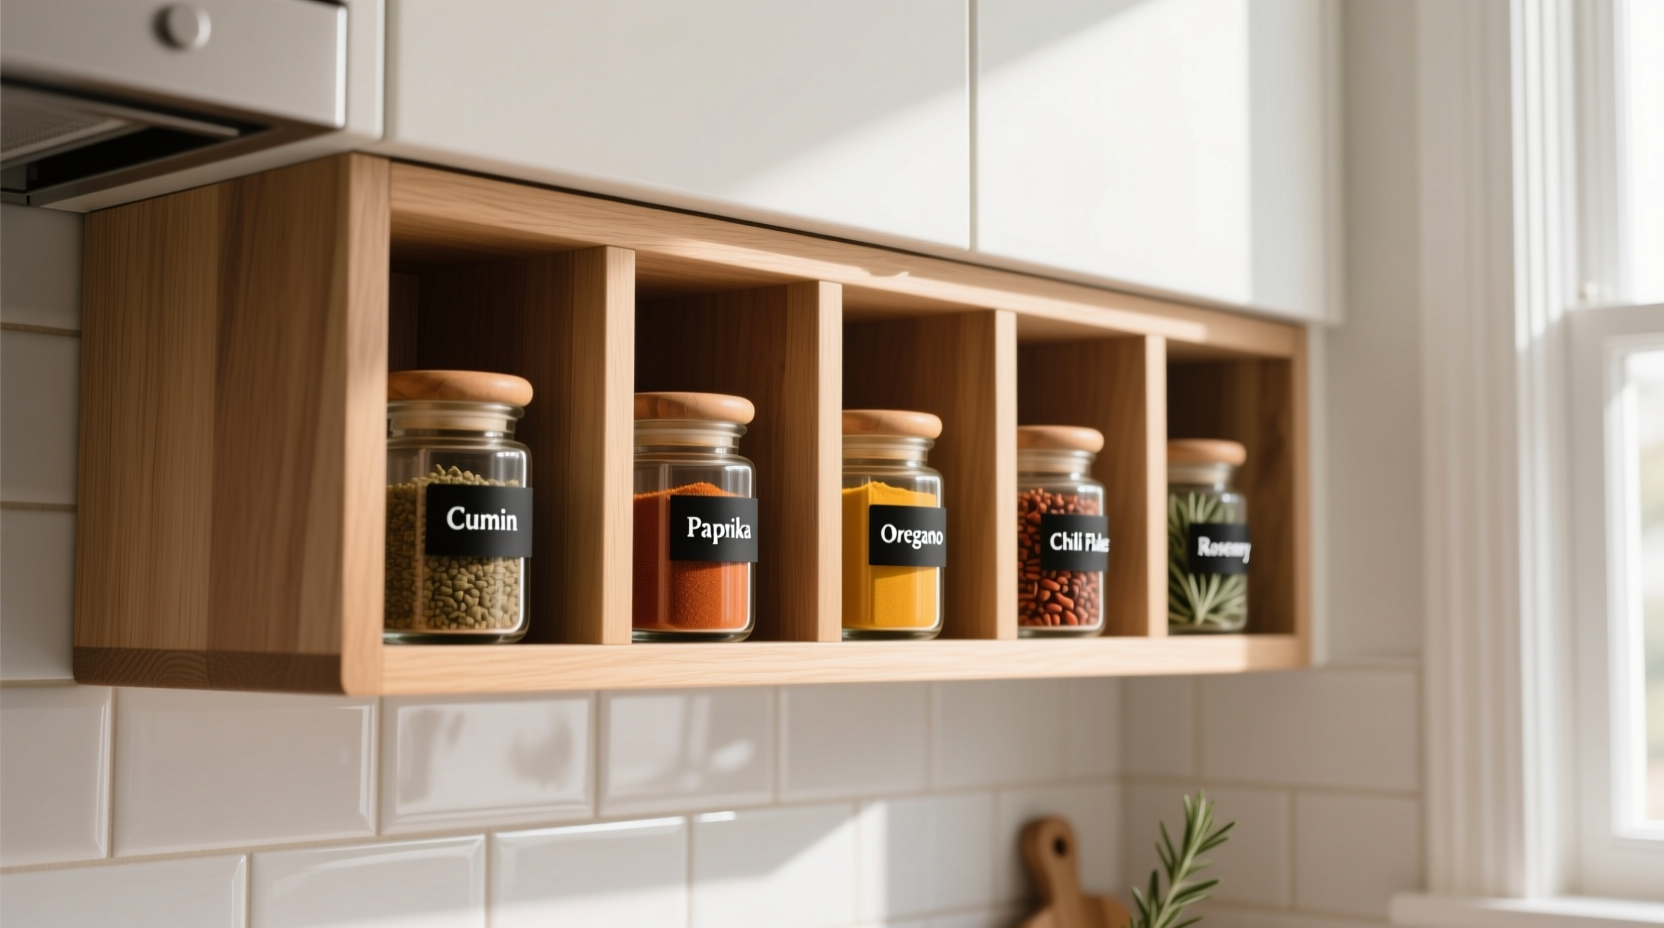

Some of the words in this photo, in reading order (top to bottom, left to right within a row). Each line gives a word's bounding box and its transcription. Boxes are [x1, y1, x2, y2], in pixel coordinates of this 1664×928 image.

[446, 505, 518, 532] Cumin
[687, 516, 752, 545] Paprika
[880, 523, 944, 550] Oregano
[1050, 531, 1083, 551] Chili
